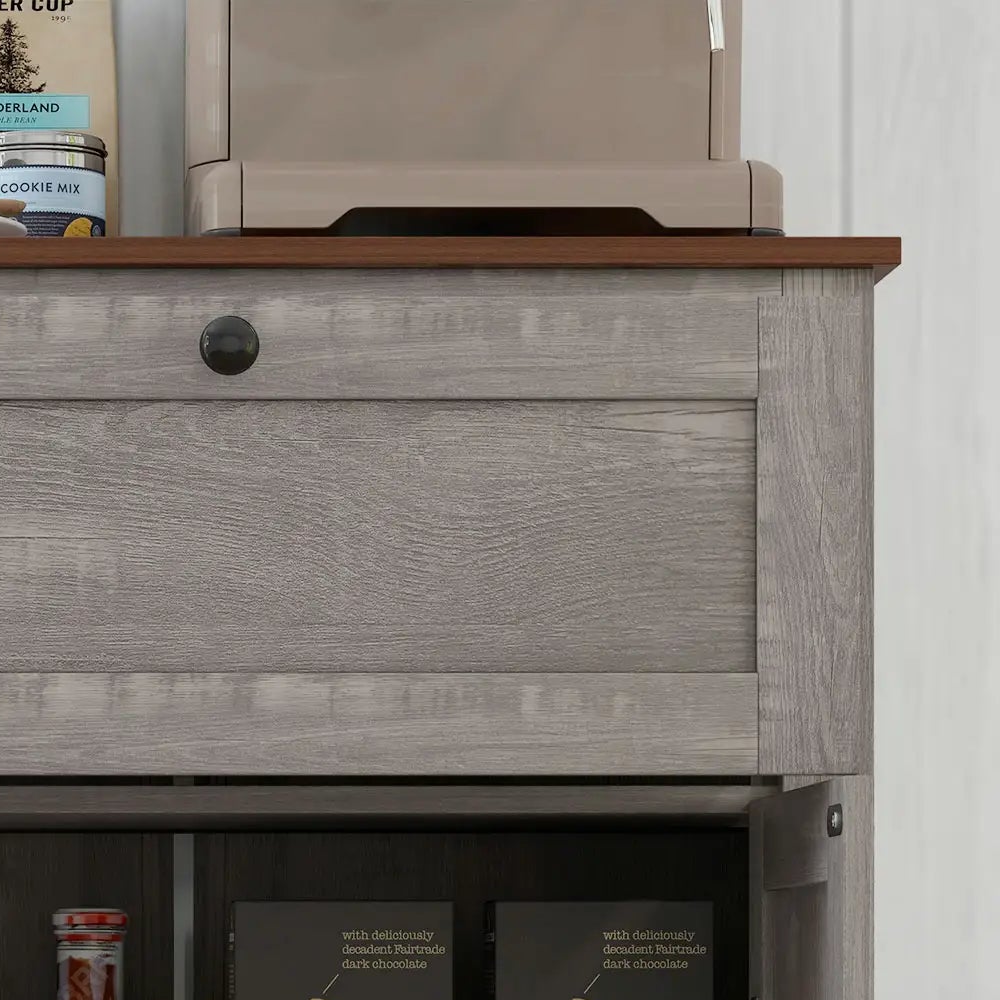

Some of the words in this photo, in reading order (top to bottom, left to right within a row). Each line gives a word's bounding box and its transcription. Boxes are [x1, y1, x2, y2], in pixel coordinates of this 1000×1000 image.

[31, 0, 74, 12] CUP
[14, 116, 37, 124] BEAN
[0, 182, 54, 194] COOKIE
[57, 183, 80, 194] MIX
[342, 929, 369, 940] with
[372, 929, 434, 943] deliciously
[603, 929, 630, 940] with
[633, 929, 695, 943] deliciously
[342, 943, 392, 955] decadent
[394, 943, 446, 955] Fairtrade
[603, 943, 653, 955] decadent
[655, 943, 707, 955] Fairtrade
[342, 958, 370, 969] dark
[372, 958, 427, 969] chocolate
[603, 958, 631, 969] dark
[633, 958, 688, 969] chocolate
